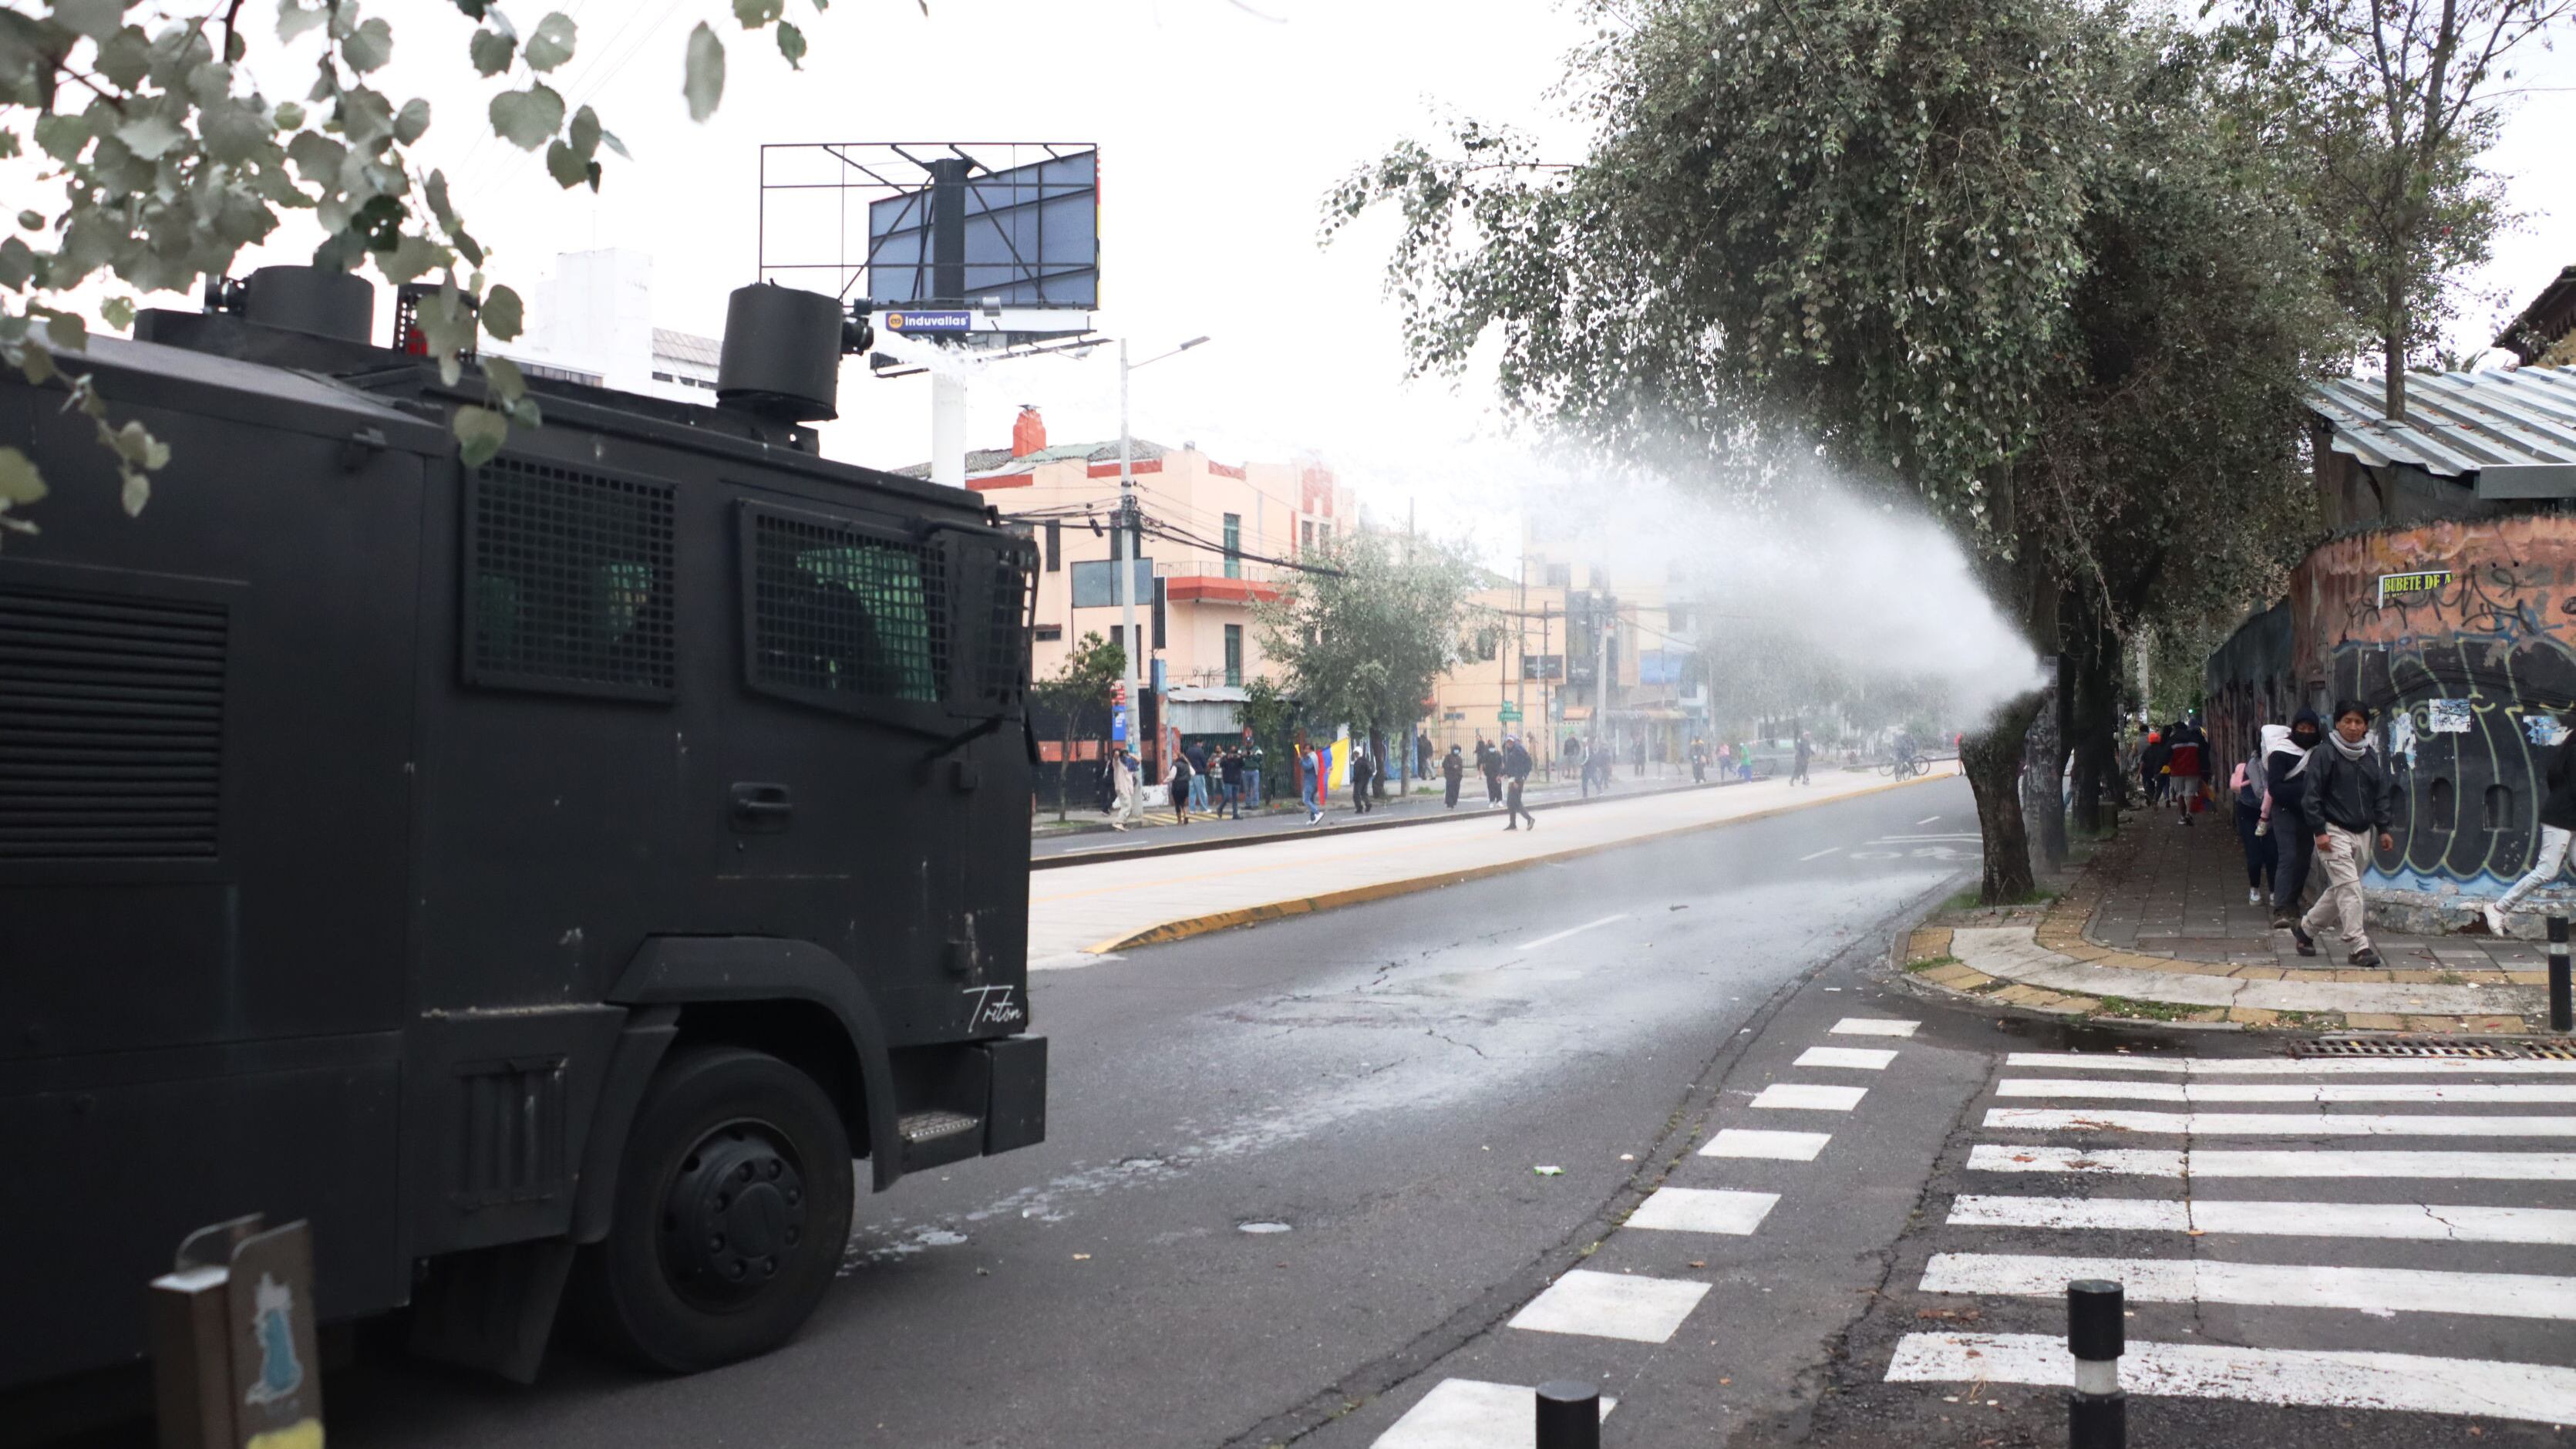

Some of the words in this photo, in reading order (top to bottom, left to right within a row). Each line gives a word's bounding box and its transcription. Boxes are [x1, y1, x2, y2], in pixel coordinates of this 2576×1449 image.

[904, 316, 966, 326] Induvallas
[2384, 575, 2421, 593] BUBETE
[962, 985, 1022, 1033] Triton
